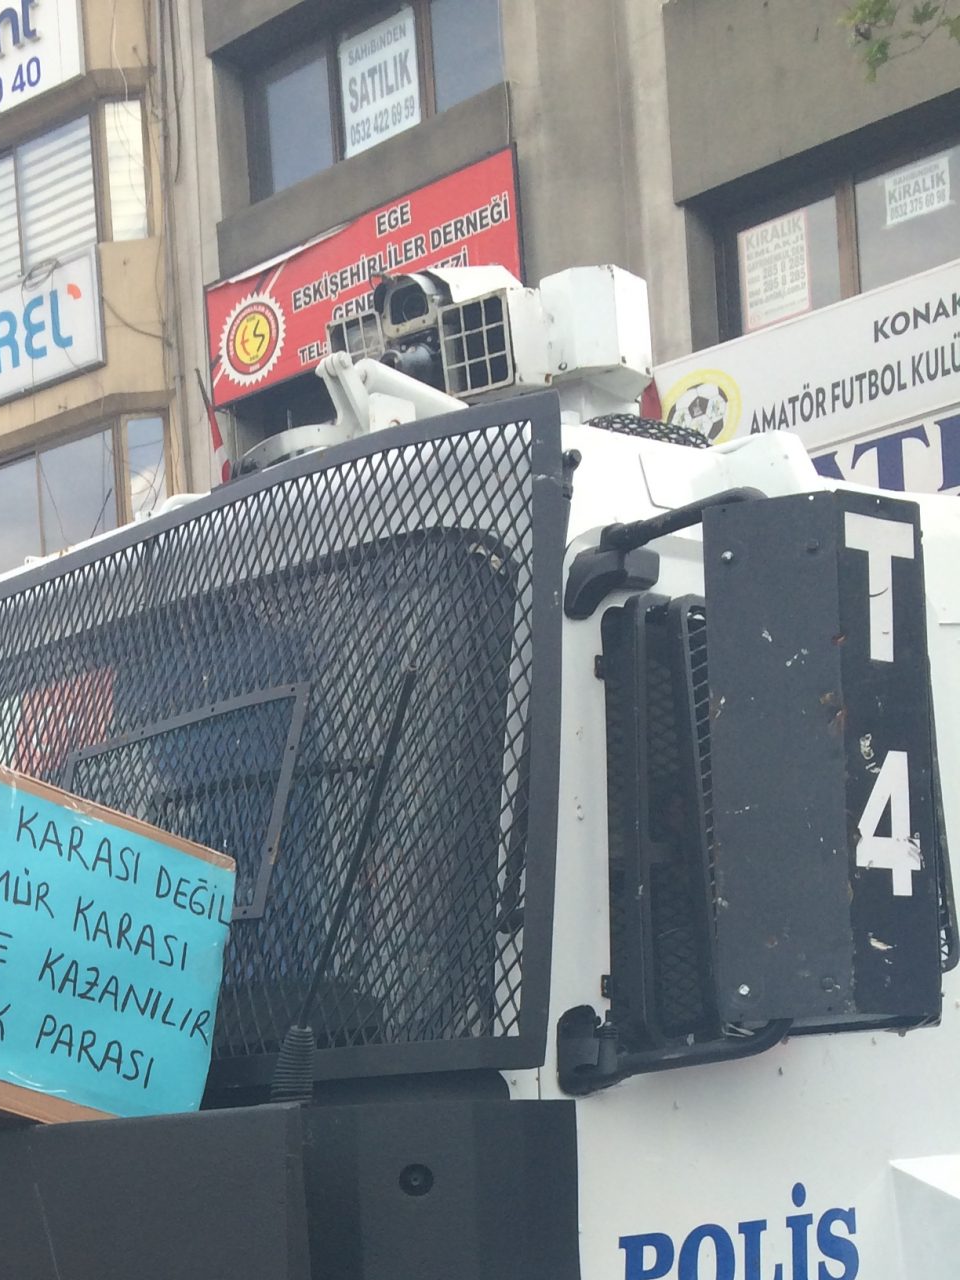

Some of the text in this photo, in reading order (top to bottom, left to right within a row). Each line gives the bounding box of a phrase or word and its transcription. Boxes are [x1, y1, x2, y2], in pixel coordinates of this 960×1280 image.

[11, 56, 41, 93] 40
[348, 49, 412, 114] SATILIK
[350, 95, 415, 147] 0532 422 69 59
[292, 191, 511, 313] ESKİŞEHİRLİLER DERNEĞİ
[376, 200, 411, 238] EGE
[298, 340, 329, 366] TEL:
[750, 382, 826, 435] AMATÖR
[831, 360, 907, 413] FUTBOL
[16, 805, 141, 885] KARASI
[155, 866, 232, 927] DEĞİL
[74, 896, 188, 971] KARASI
[39, 947, 211, 1046] KAZANILIR
[35, 1014, 154, 1089] PARASI
